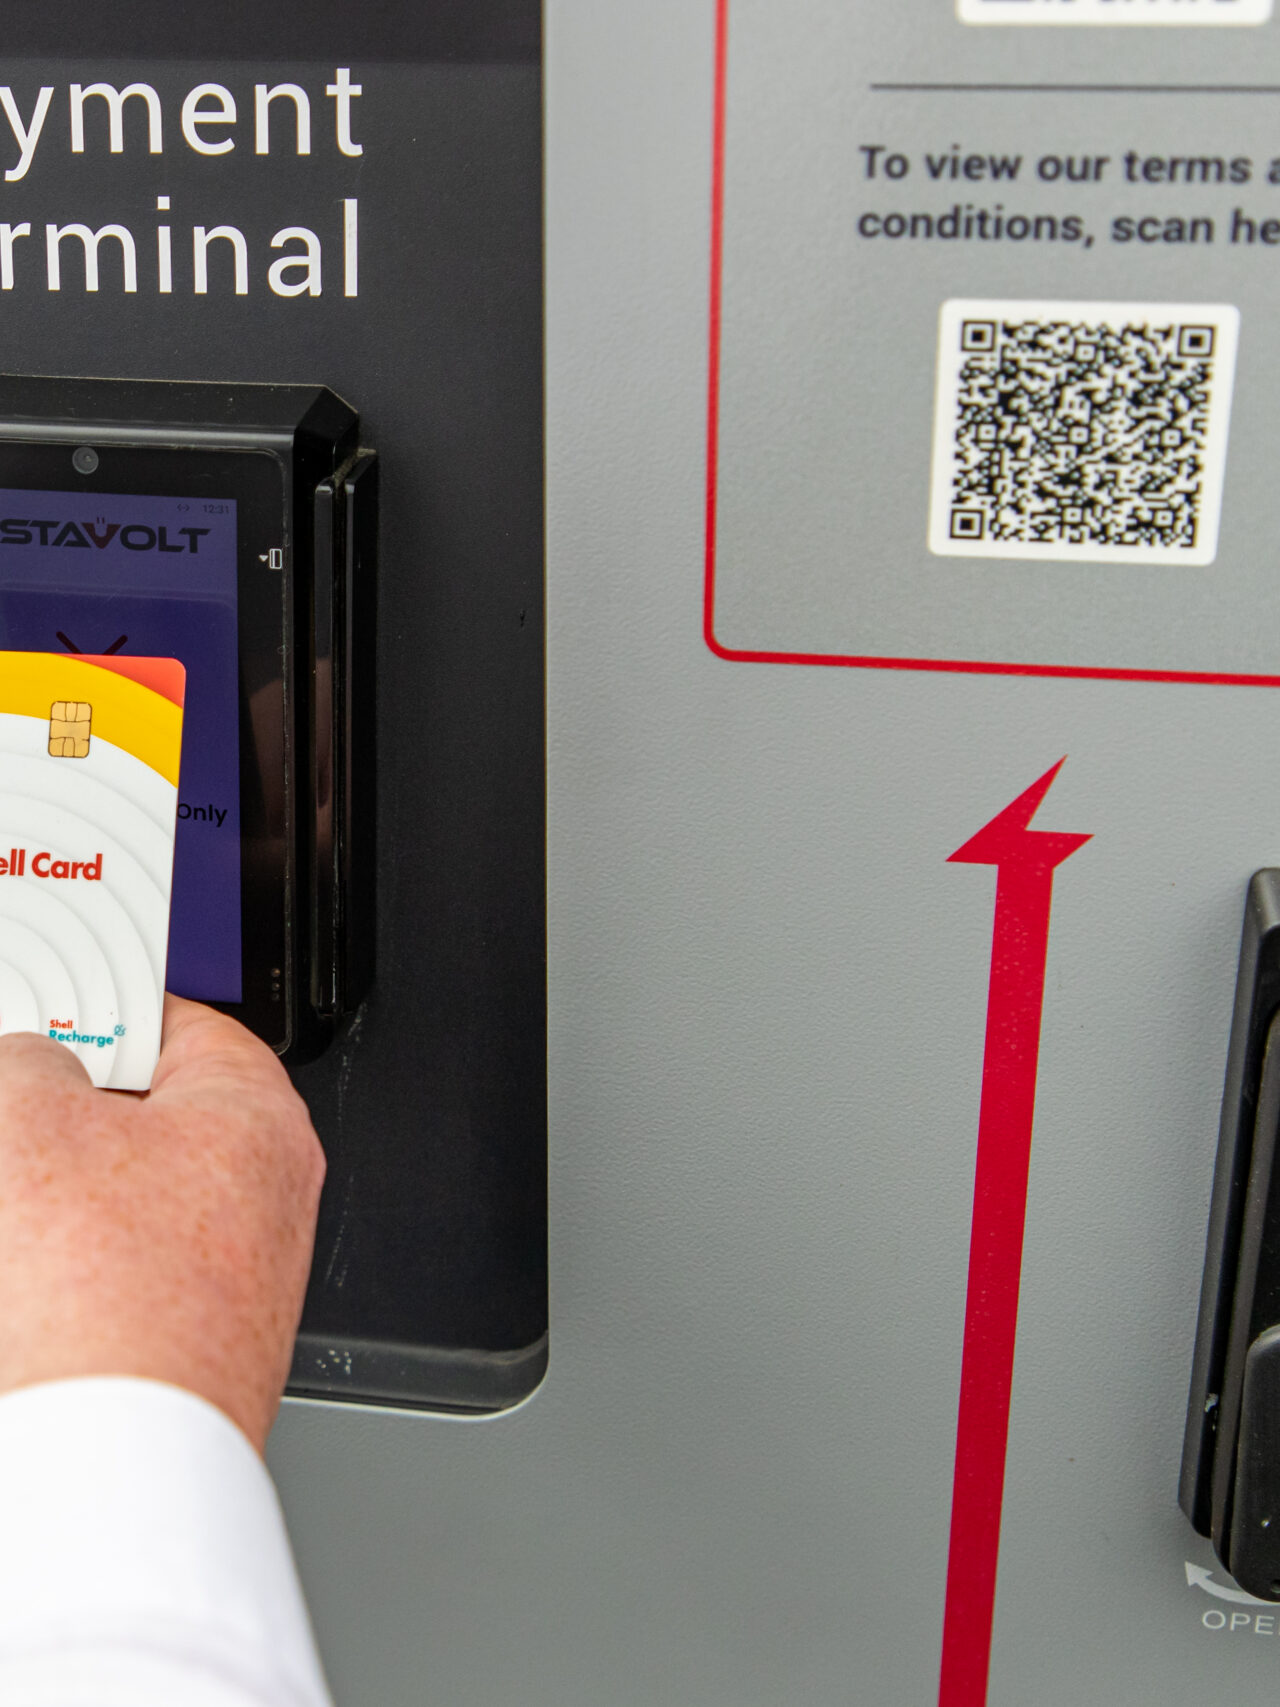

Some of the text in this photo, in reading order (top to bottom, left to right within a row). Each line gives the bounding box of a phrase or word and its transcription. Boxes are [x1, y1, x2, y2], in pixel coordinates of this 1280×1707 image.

[858, 145, 910, 182] To
[924, 144, 1022, 182] view
[1036, 153, 1110, 183] our
[1123, 150, 1253, 184] terms
[857, 205, 1096, 249] conditions,
[1111, 213, 1215, 244] scan
[177, 803, 228, 828] Only
[31, 852, 103, 881] Card
[49, 1018, 74, 1030] Shell
[48, 1029, 115, 1048] Recharge
[1201, 1609, 1280, 1636] OPE
